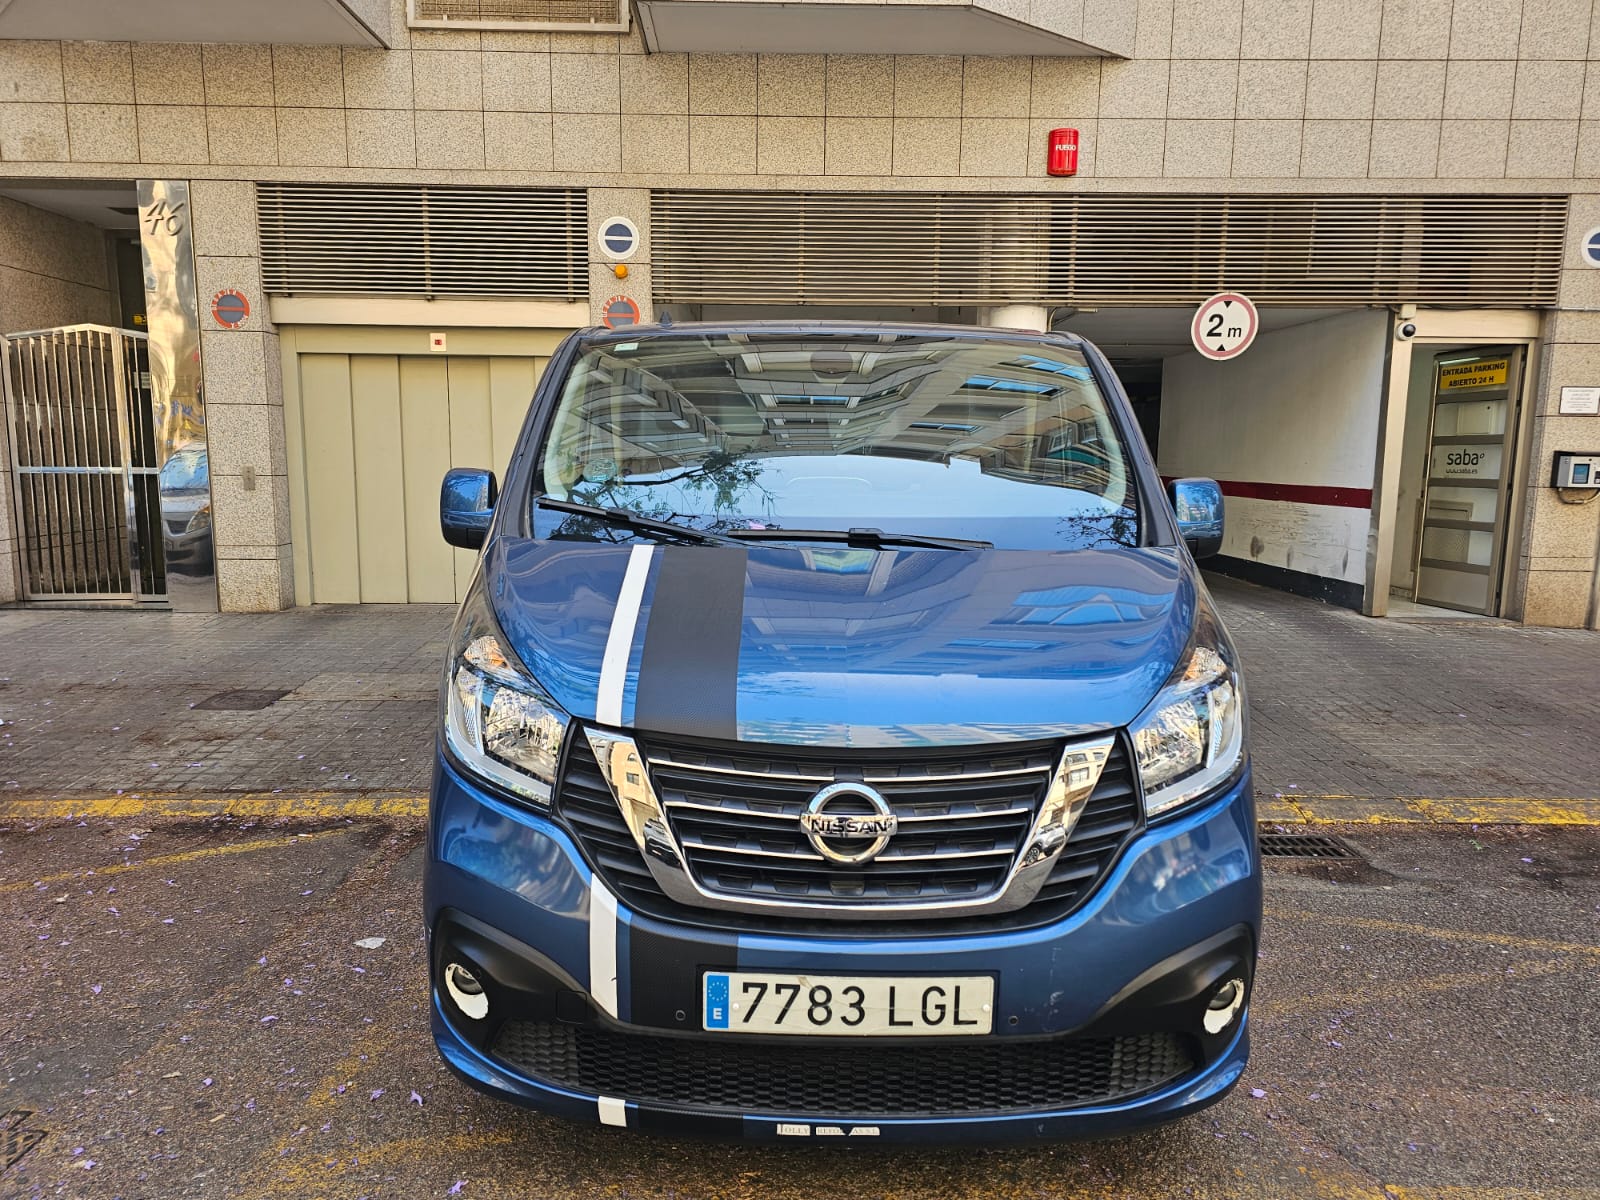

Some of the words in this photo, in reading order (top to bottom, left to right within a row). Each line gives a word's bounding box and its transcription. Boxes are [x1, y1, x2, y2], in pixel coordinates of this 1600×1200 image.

[143, 200, 185, 237] 46
[1206, 313, 1224, 337] 2
[1227, 327, 1242, 338] m
[1442, 366, 1473, 377] ENTRADA
[1474, 362, 1505, 373] PARKING
[1448, 377, 1477, 387] ABIERTO
[1478, 376, 1487, 384] 24
[1488, 375, 1495, 383] H
[811, 819, 889, 834] NISSAN
[742, 981, 865, 1026] 7783
[888, 985, 978, 1027] LGL
[713, 1007, 723, 1020] E
